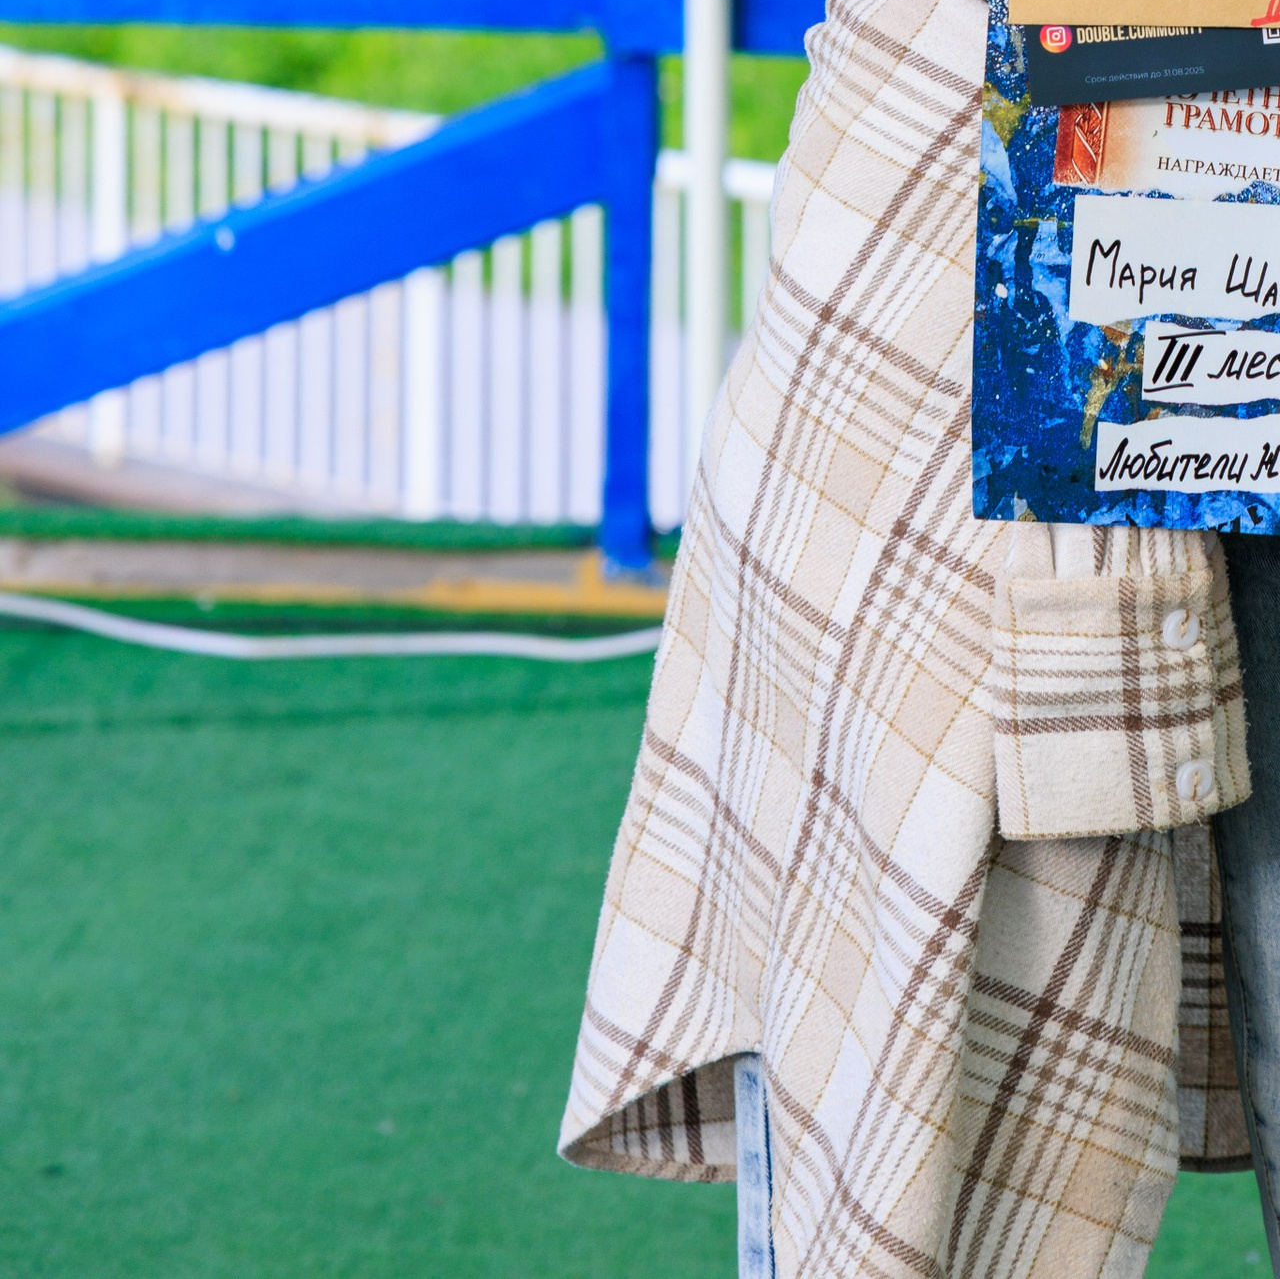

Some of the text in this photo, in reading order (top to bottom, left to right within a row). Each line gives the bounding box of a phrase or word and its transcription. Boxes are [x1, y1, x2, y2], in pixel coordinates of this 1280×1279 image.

[1084, 75, 1107, 84] Срок
[1108, 72, 1149, 83] действия
[1150, 71, 1162, 79] до
[1086, 239, 1197, 304] Мария
[1099, 437, 1249, 484] Любители
